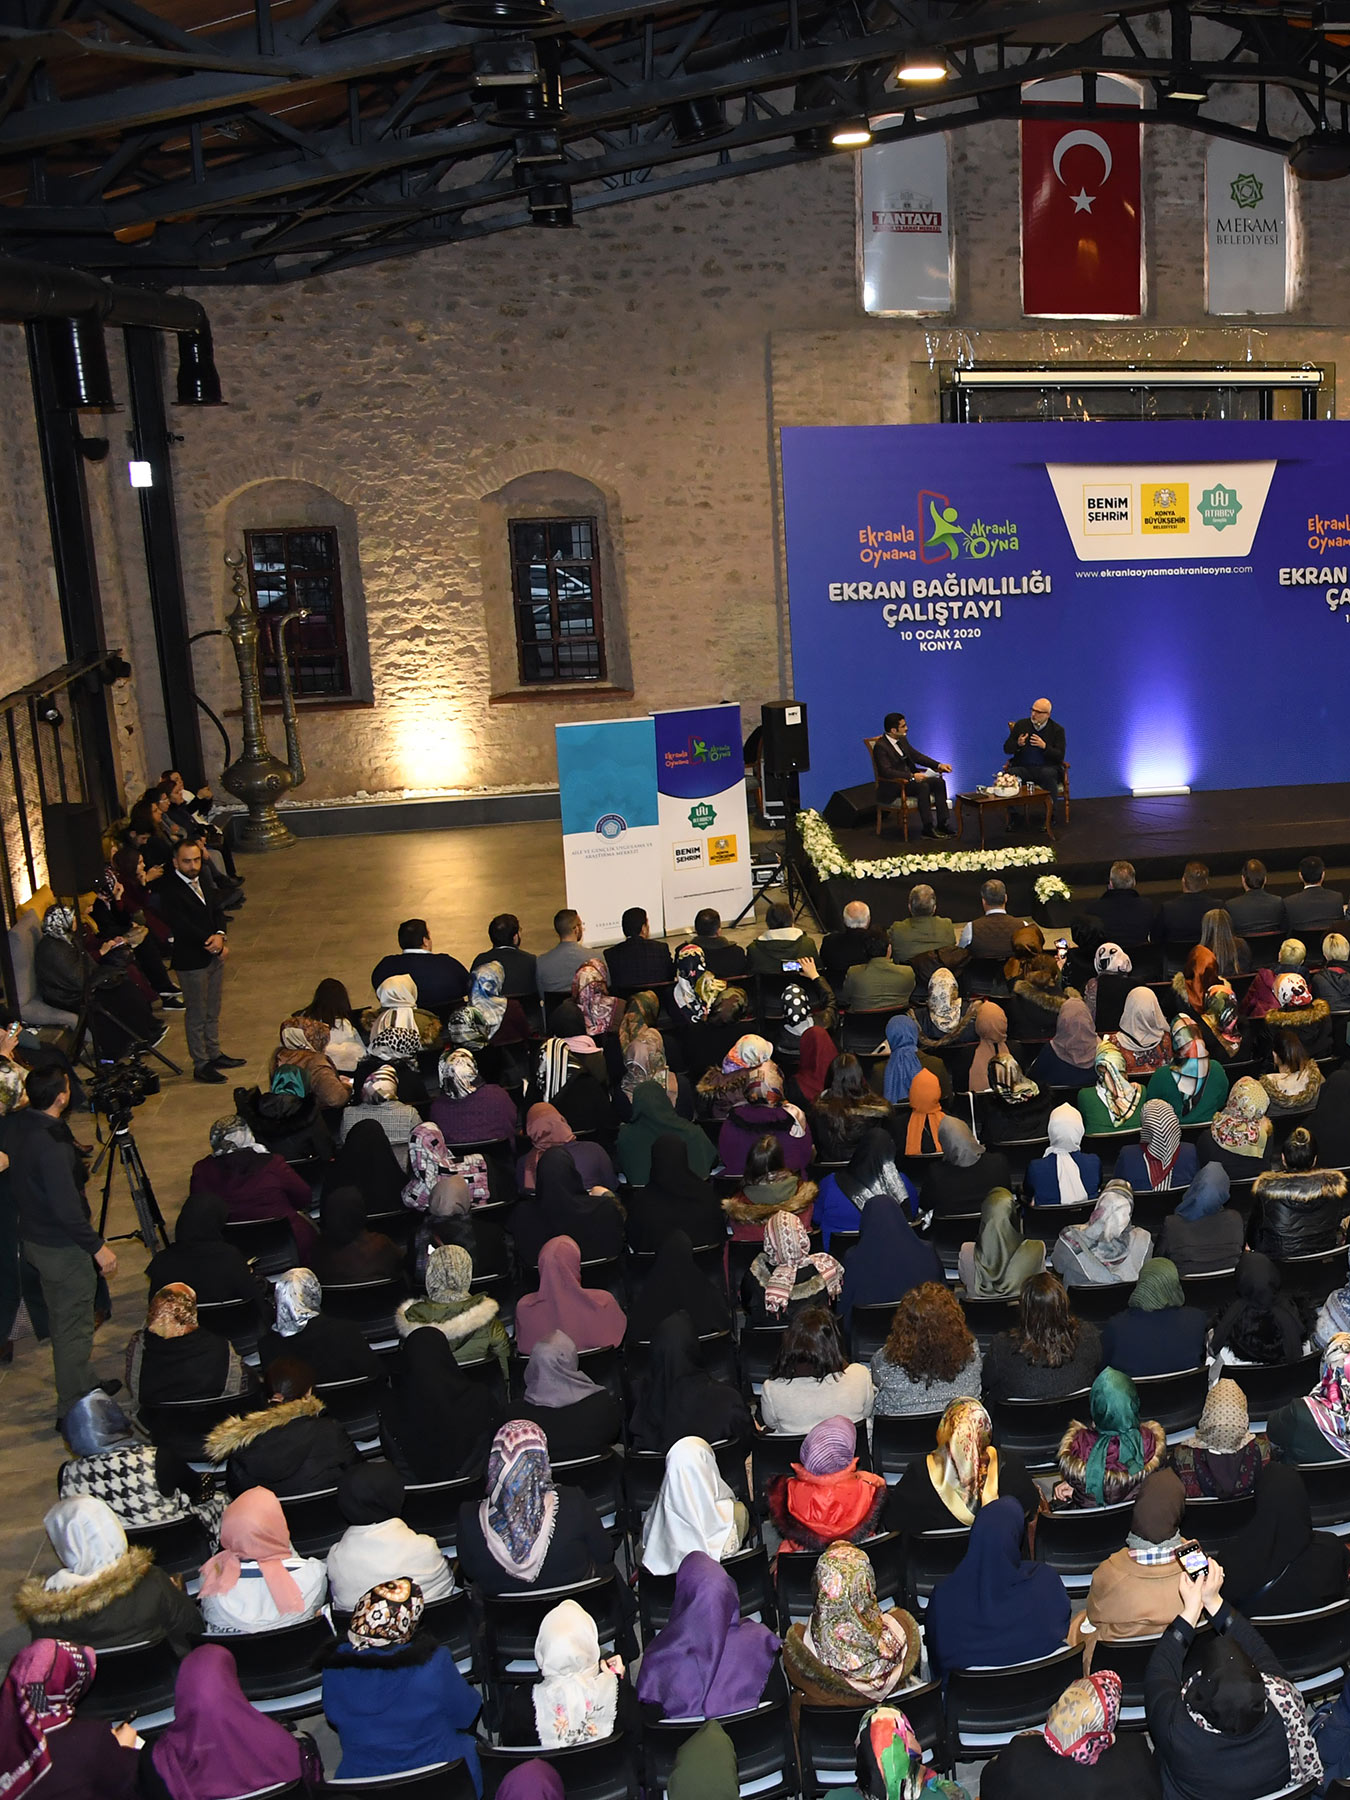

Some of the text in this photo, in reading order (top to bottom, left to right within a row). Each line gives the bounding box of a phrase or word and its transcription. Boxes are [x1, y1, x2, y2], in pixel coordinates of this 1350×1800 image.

[1216, 218, 1277, 232] MERAM
[859, 525, 914, 548] Ekranla
[970, 518, 1017, 537] Akranla
[970, 537, 1019, 559] Oyna
[860, 548, 916, 568] Oynama
[1075, 566, 1253, 578] www.ekranlaoynamaakranlaoyna.com
[1279, 566, 1347, 585] EKRAN
[828, 569, 1052, 601] EKRAN BAĞIMLILIĞI
[883, 600, 1001, 628] ÇALIŞTAYI
[900, 628, 981, 641] 10 OCAK 2020
[919, 639, 962, 652] KONYA
